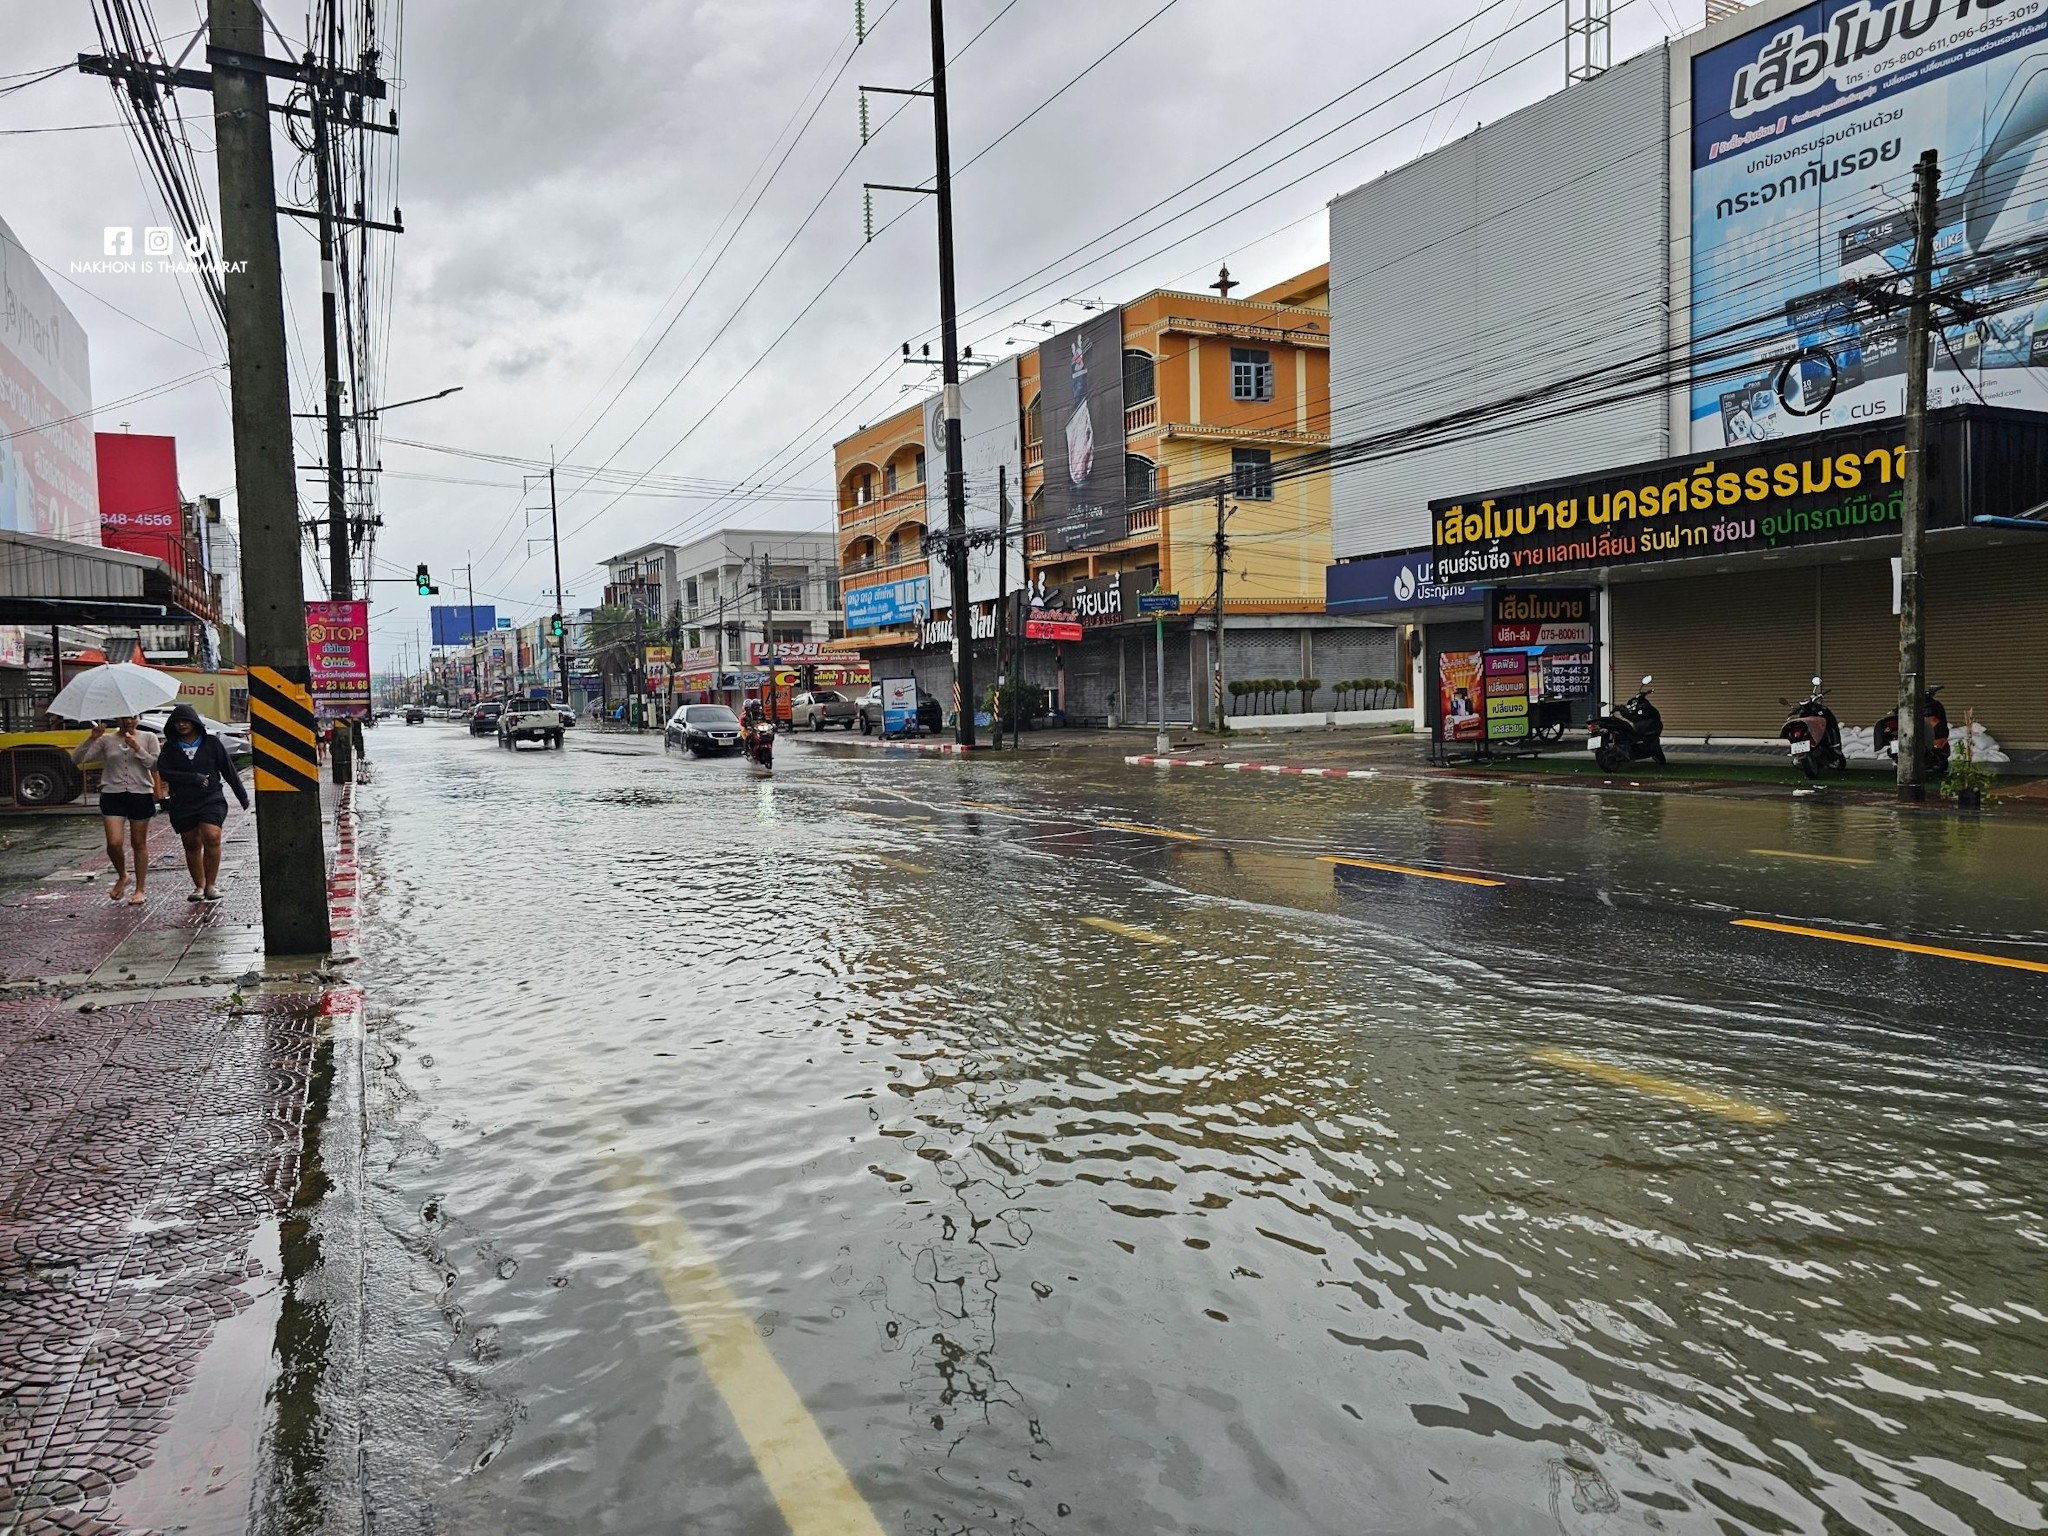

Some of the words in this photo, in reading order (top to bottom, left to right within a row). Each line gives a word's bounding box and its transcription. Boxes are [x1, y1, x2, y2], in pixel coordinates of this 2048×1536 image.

[1734, 0, 2003, 108] เสือโมบ
[1846, 71, 1864, 86] โทร
[1747, 108, 1904, 174] ปกป้องครบรอบด้านด้วย
[1716, 137, 1902, 220] กระจกกันรอย
[1819, 400, 1887, 426] FOCUS
[100, 512, 173, 526] 648-4556
[1436, 498, 1578, 546] เสือโมบาย
[1438, 539, 1510, 583] ศูนย์รับซื้อ
[1512, 547, 1543, 567] ขาย
[1547, 524, 1636, 563] แลกเปลี่ยน
[1640, 523, 1708, 553] รับฝาก
[1711, 517, 1756, 543] ซ่อม
[1761, 490, 1903, 546] อุปกรณ์มือถื
[1498, 594, 1583, 620] เสือโมบาย
[307, 623, 365, 644] OTOP
[1498, 626, 1530, 642] ปลีก-ส่ง
[326, 680, 337, 690] 23
[357, 680, 368, 690] 68
[1488, 678, 1525, 693] เปลี่ยนแบต
[1492, 700, 1524, 714] เปลี่ยนจอ
